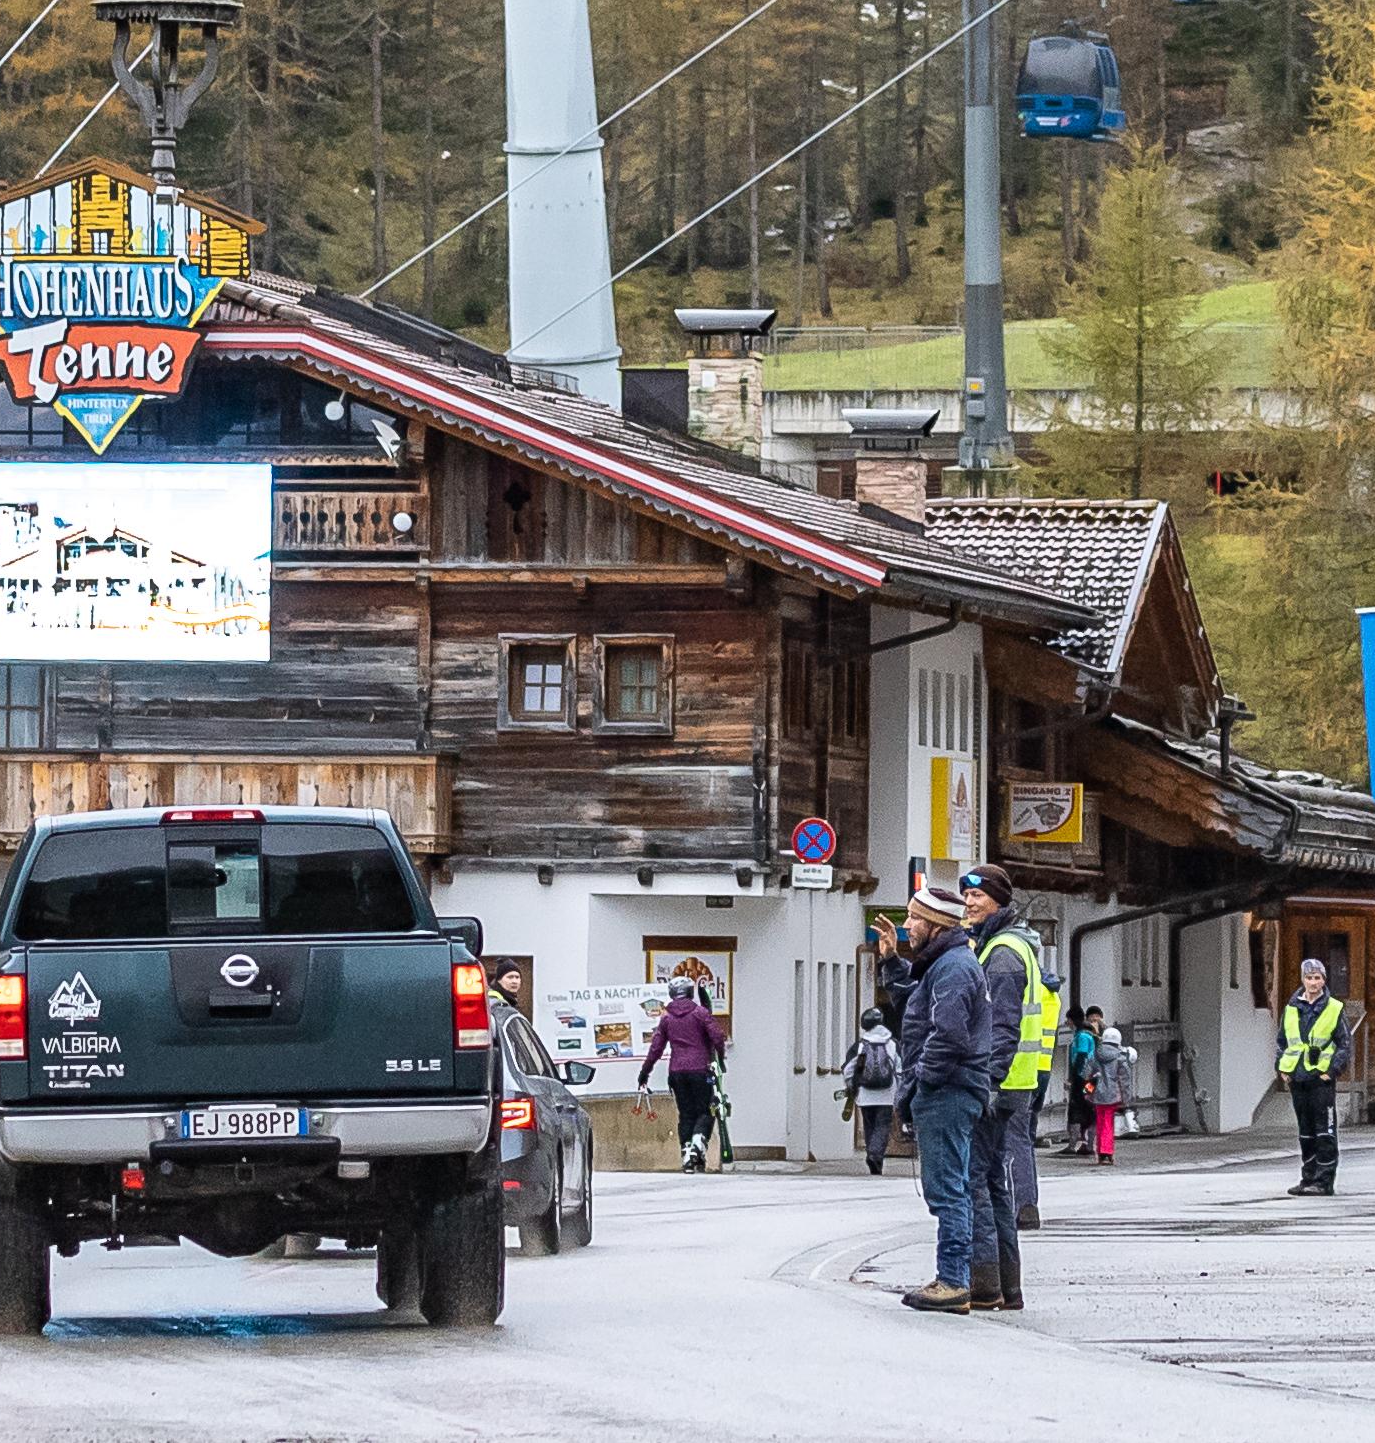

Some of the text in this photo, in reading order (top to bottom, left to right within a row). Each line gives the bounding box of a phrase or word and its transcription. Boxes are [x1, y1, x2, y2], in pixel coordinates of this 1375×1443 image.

[7, 318, 174, 404] Tenne
[67, 398, 129, 410] HINTERTUX
[82, 414, 115, 425] TIROL
[569, 989, 592, 1001] TAG
[594, 989, 602, 1000] &
[604, 987, 642, 1000] NACHT
[41, 1036, 122, 1055] VALBIRRA
[42, 1063, 125, 1078] TITAN
[417, 1059, 442, 1071] LE
[191, 1111, 296, 1136] EJ 988PP
